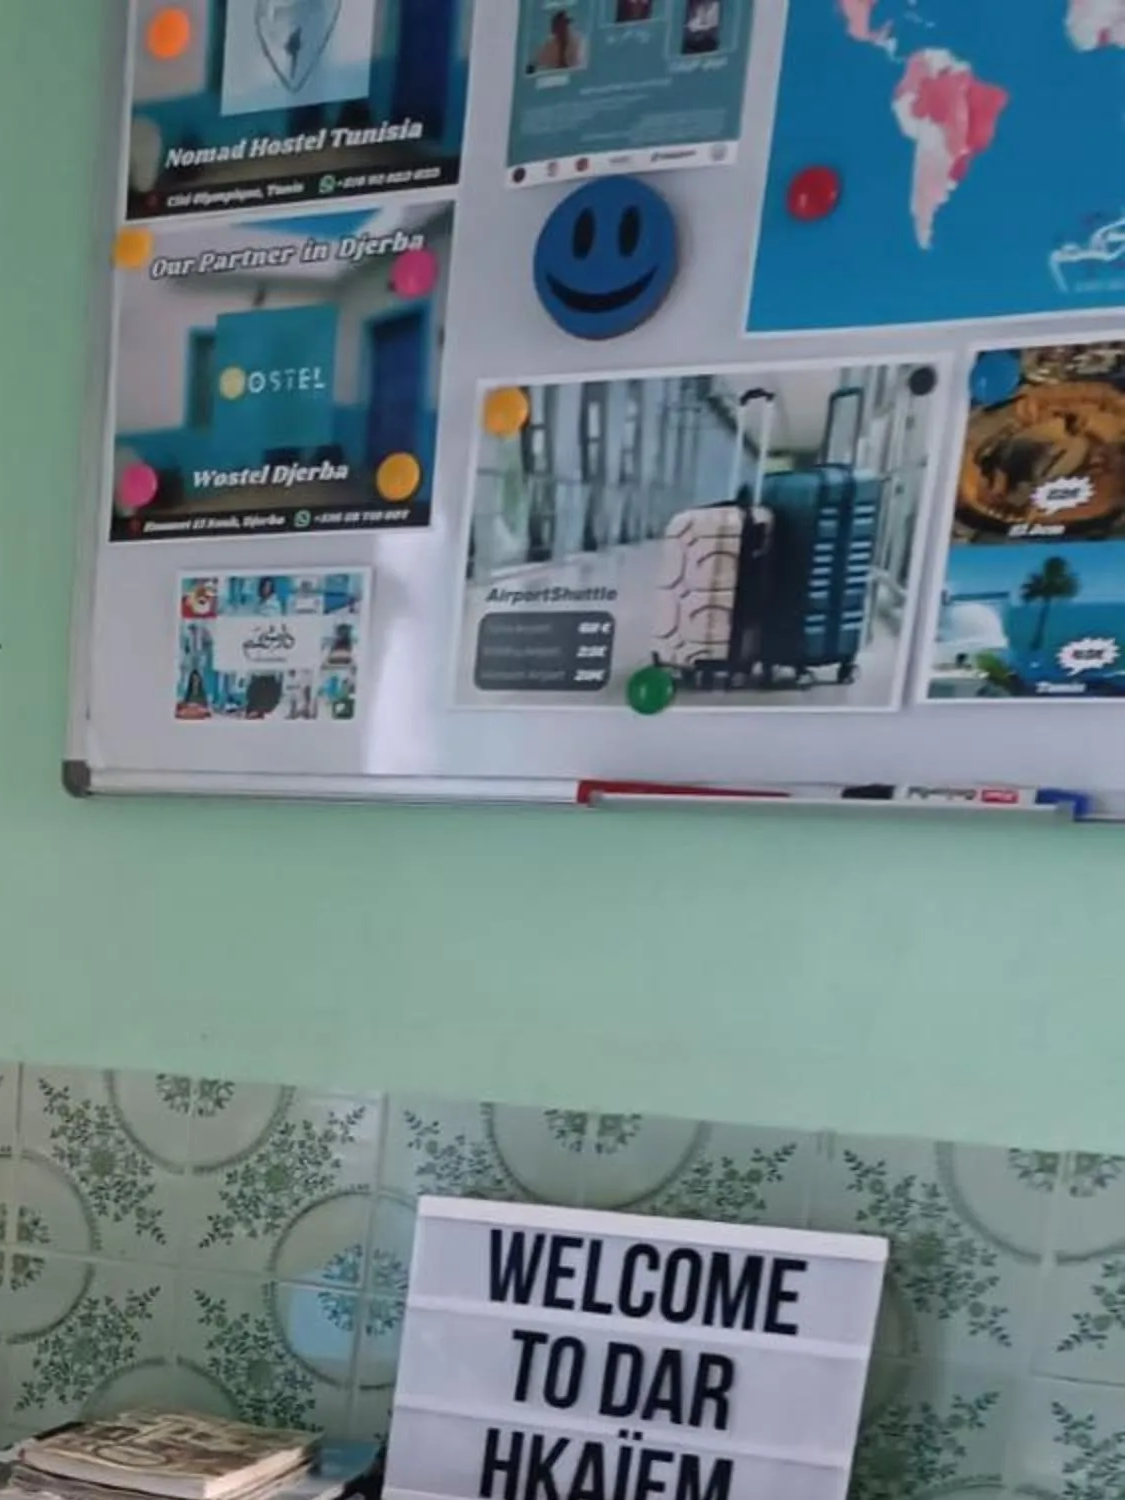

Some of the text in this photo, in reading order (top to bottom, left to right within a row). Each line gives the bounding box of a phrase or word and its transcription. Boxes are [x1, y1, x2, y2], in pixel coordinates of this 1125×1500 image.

[165, 117, 424, 169] Nomad Hostel Tunisia
[150, 230, 425, 280] Our Partner in Djerba
[247, 366, 327, 395] OSTEL
[192, 461, 350, 490] Wostel Djerba
[488, 1228, 809, 1336] WELCOME
[510, 1329, 736, 1432] TO DAR
